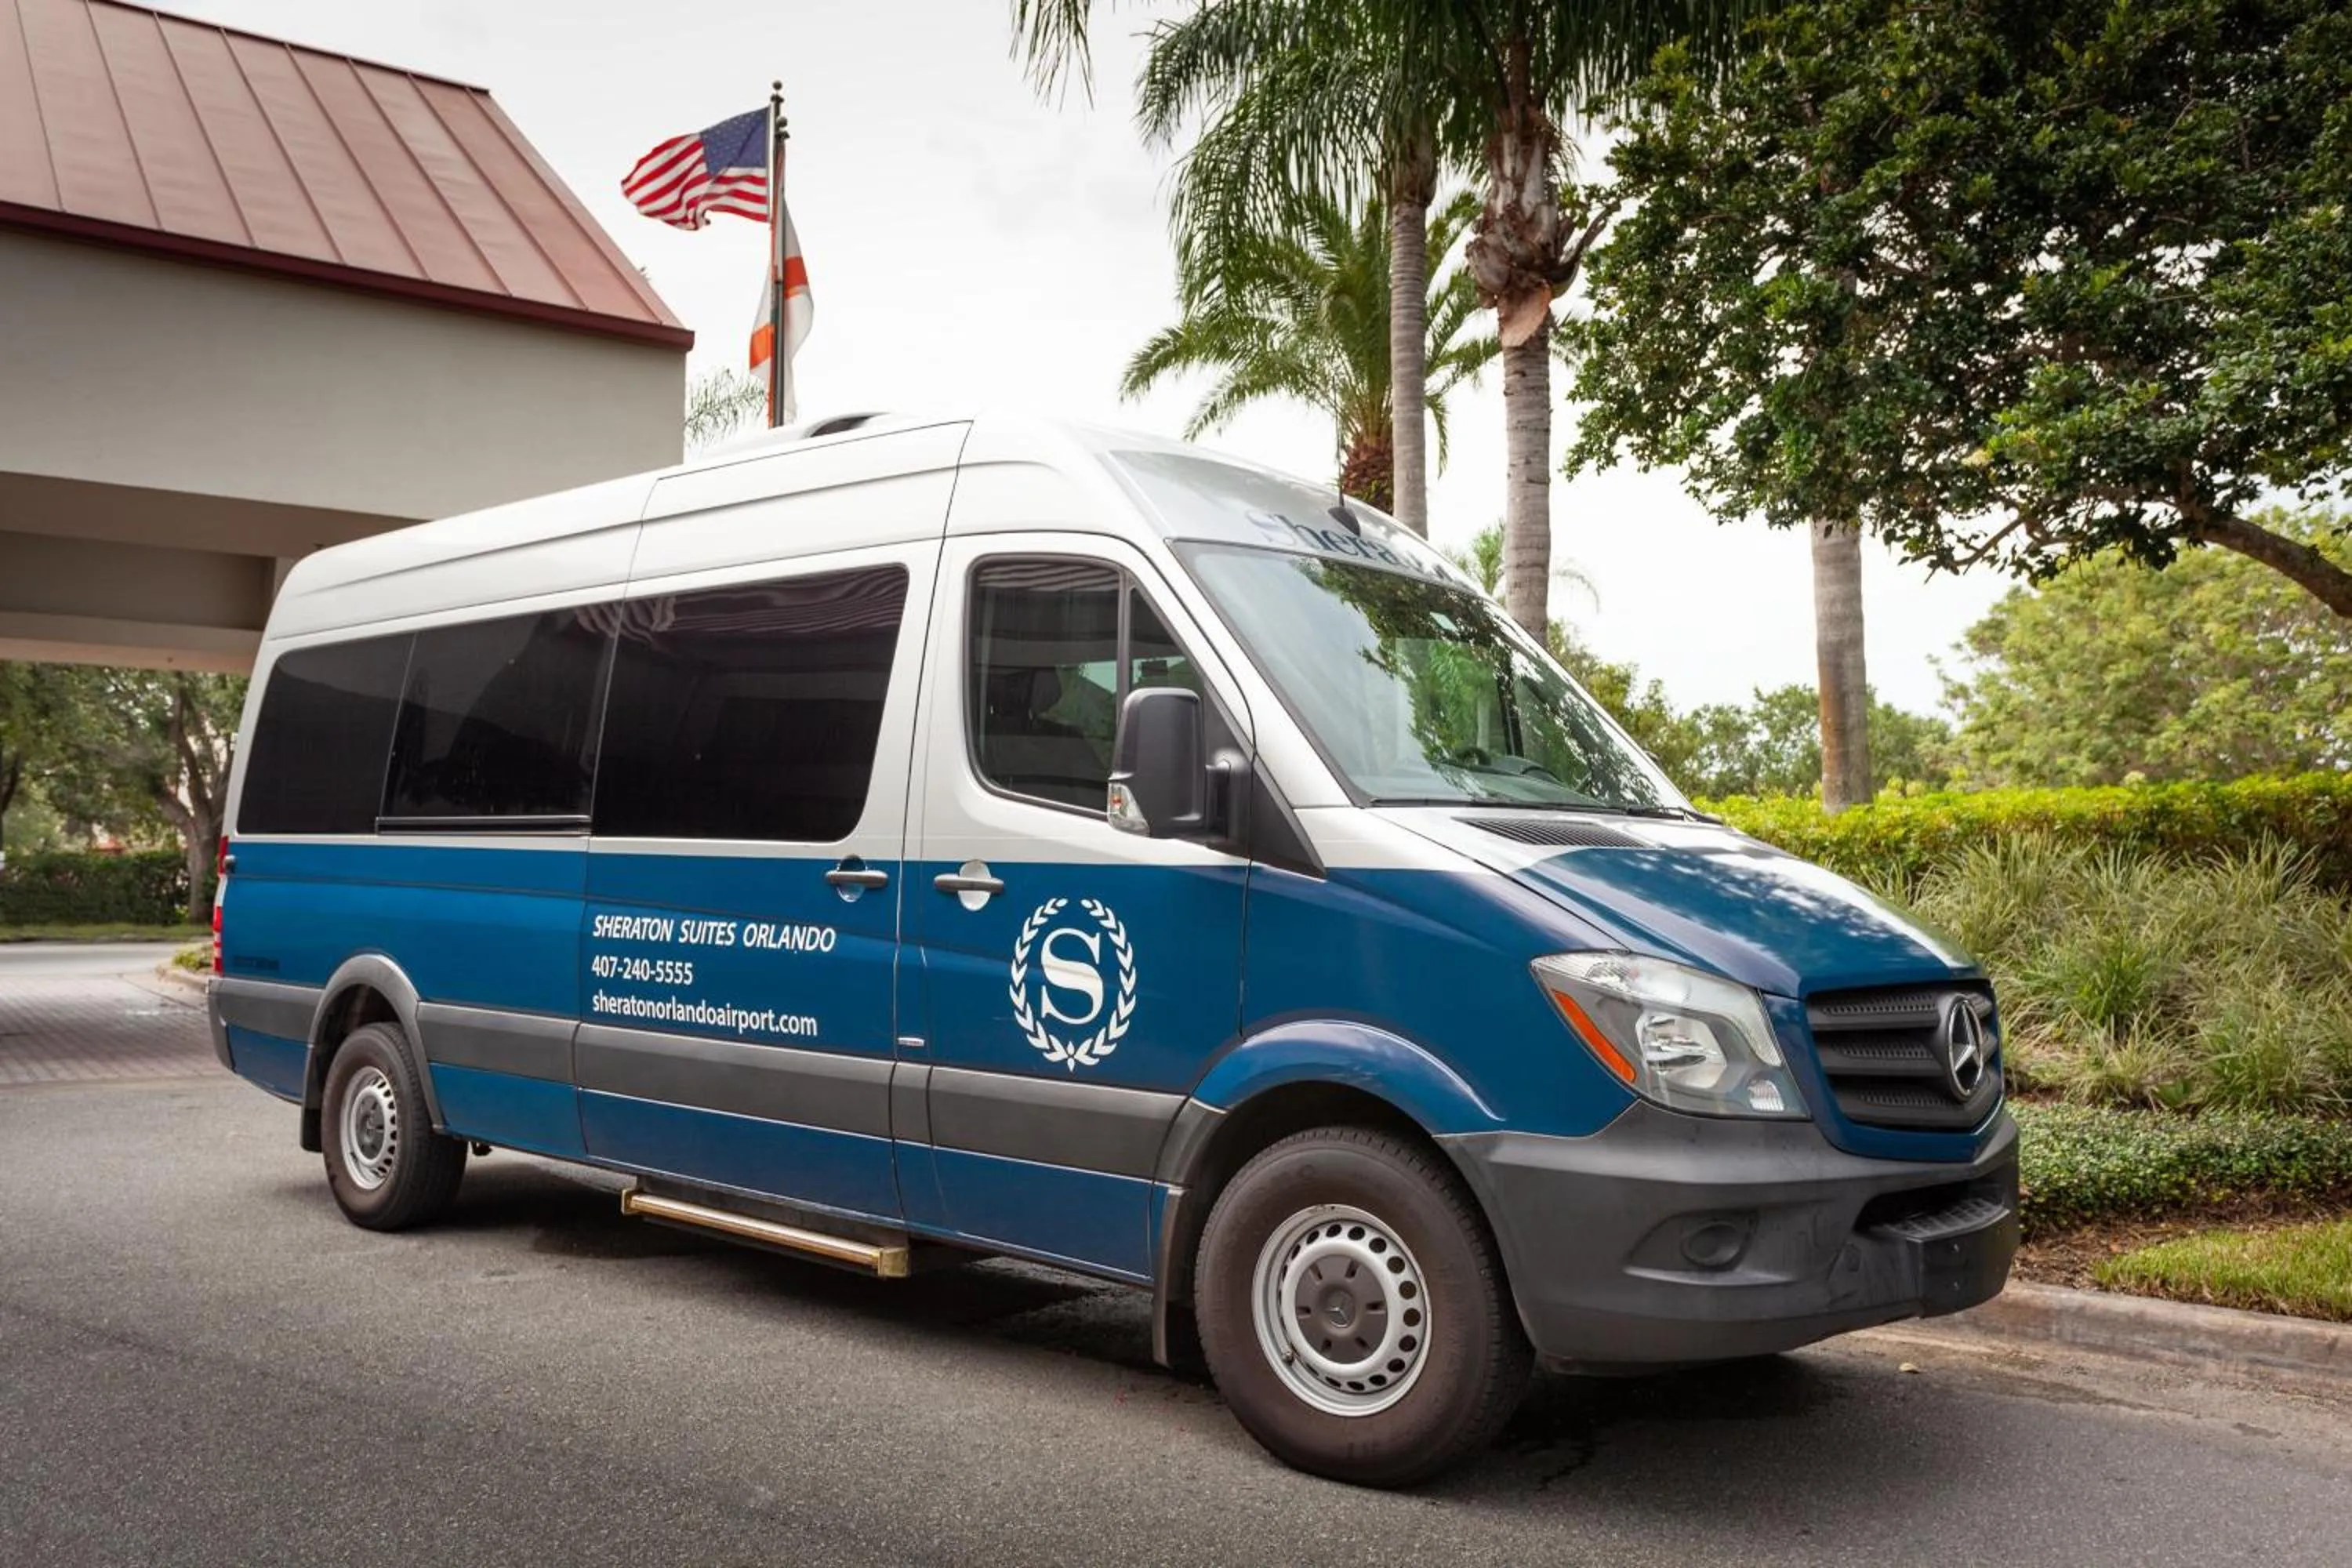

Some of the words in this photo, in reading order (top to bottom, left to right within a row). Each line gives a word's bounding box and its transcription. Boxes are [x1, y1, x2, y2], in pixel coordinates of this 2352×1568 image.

[593, 915, 674, 942] SHERATON
[678, 920, 737, 946] SUITES
[742, 923, 836, 953] ORLANDO
[591, 955, 693, 985] 407-240-5555
[1040, 927, 1104, 1025] S
[592, 989, 818, 1036] sheratonorlandoairport.com
